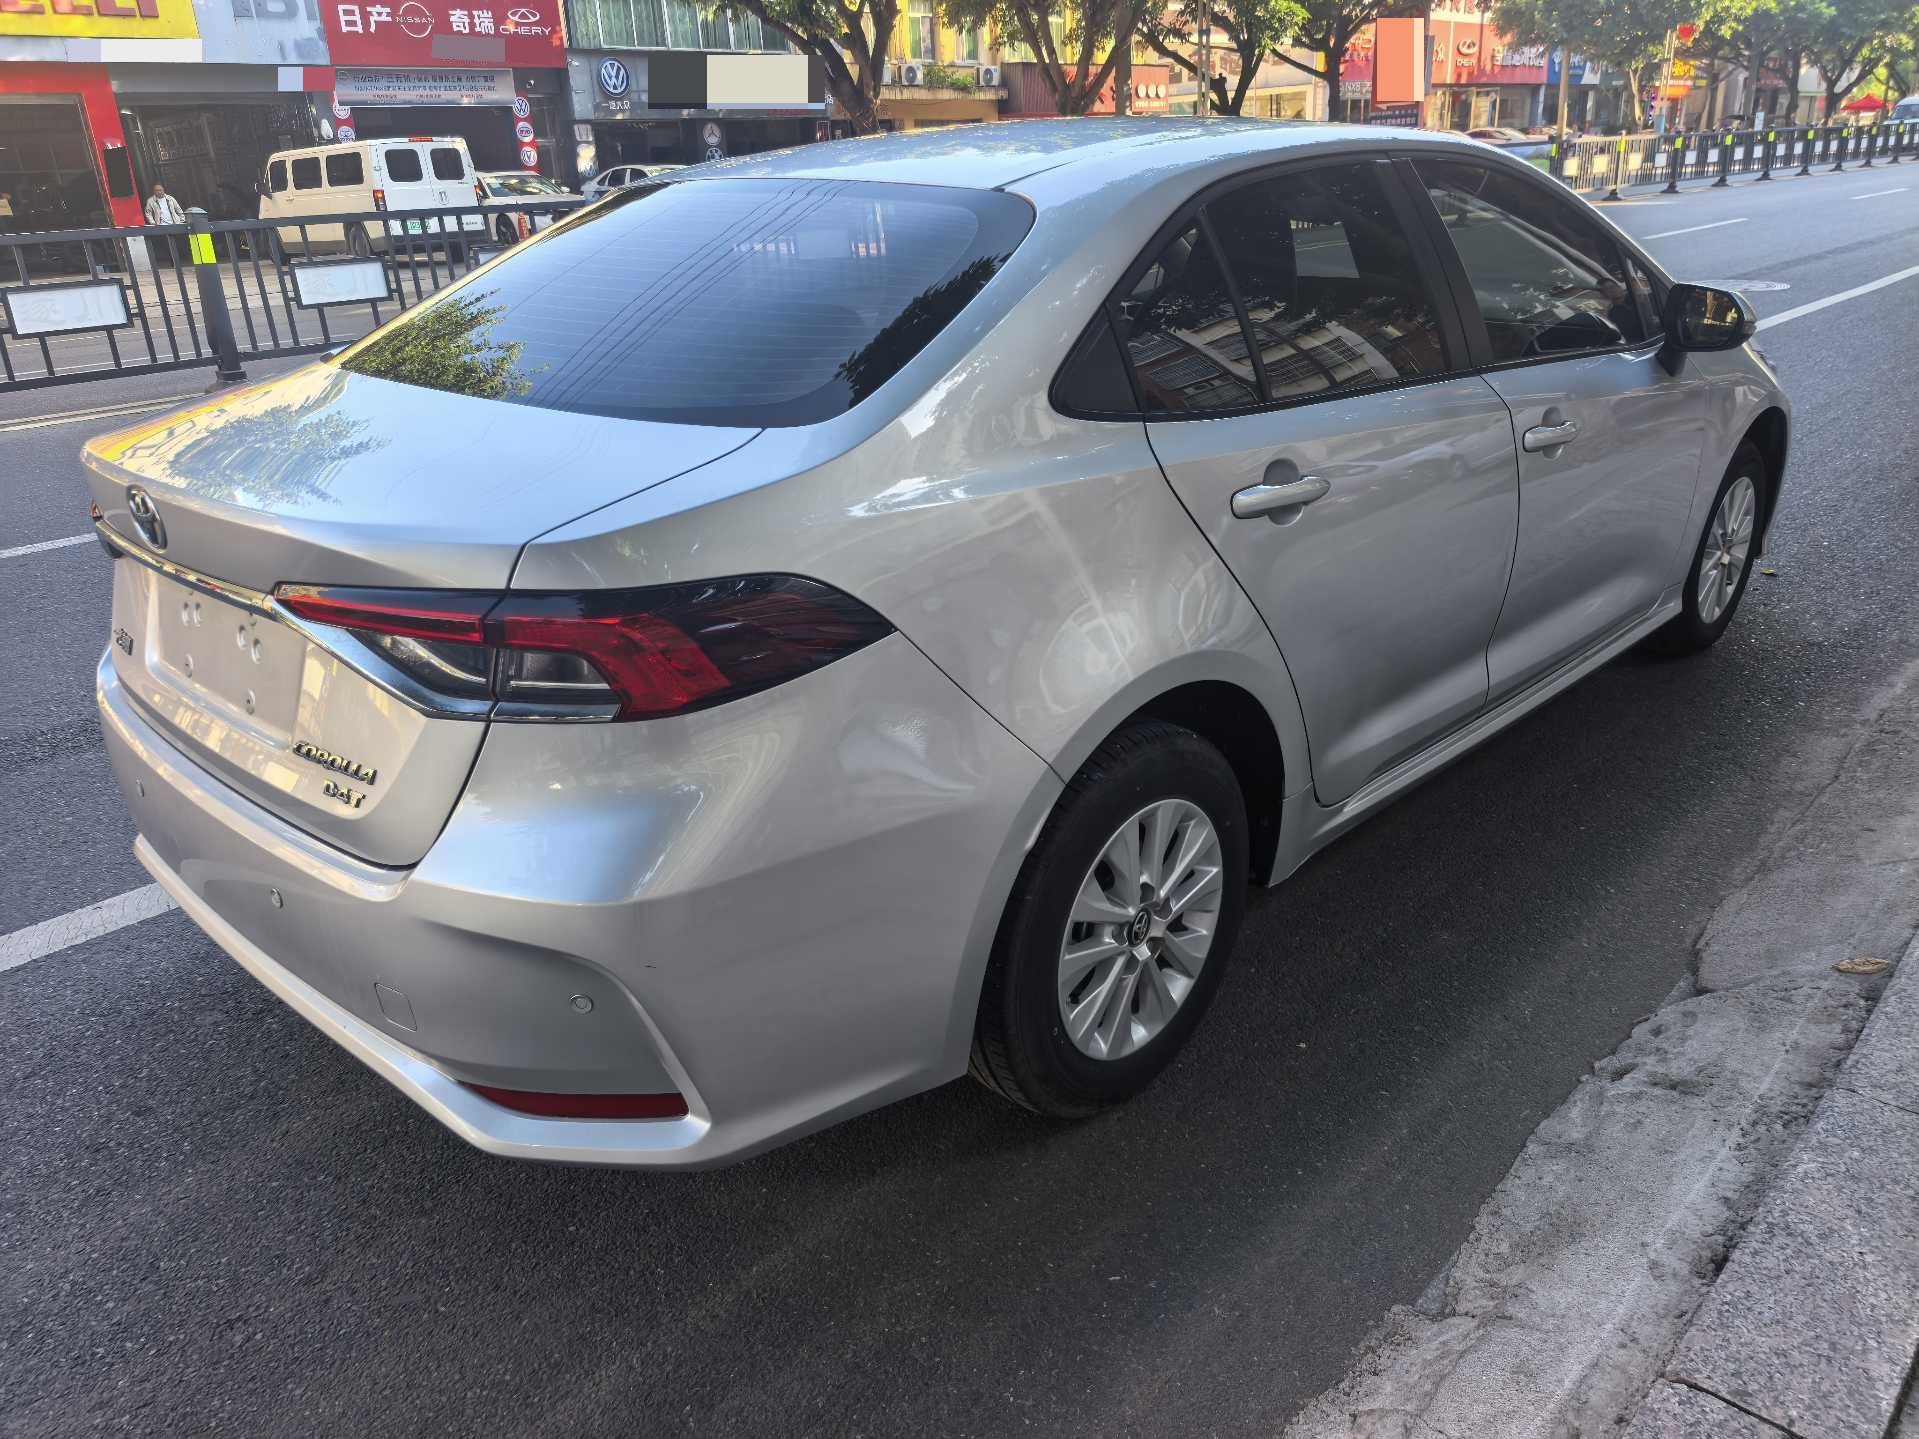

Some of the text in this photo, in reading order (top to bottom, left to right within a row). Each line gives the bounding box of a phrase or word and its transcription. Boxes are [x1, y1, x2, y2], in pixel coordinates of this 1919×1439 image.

[337, 4, 392, 33] 日产
[395, 16, 434, 24] NISSAN
[449, 9, 495, 35] 奇瑞
[499, 25, 551, 36] CHERY
[293, 741, 378, 785] COROLLA
